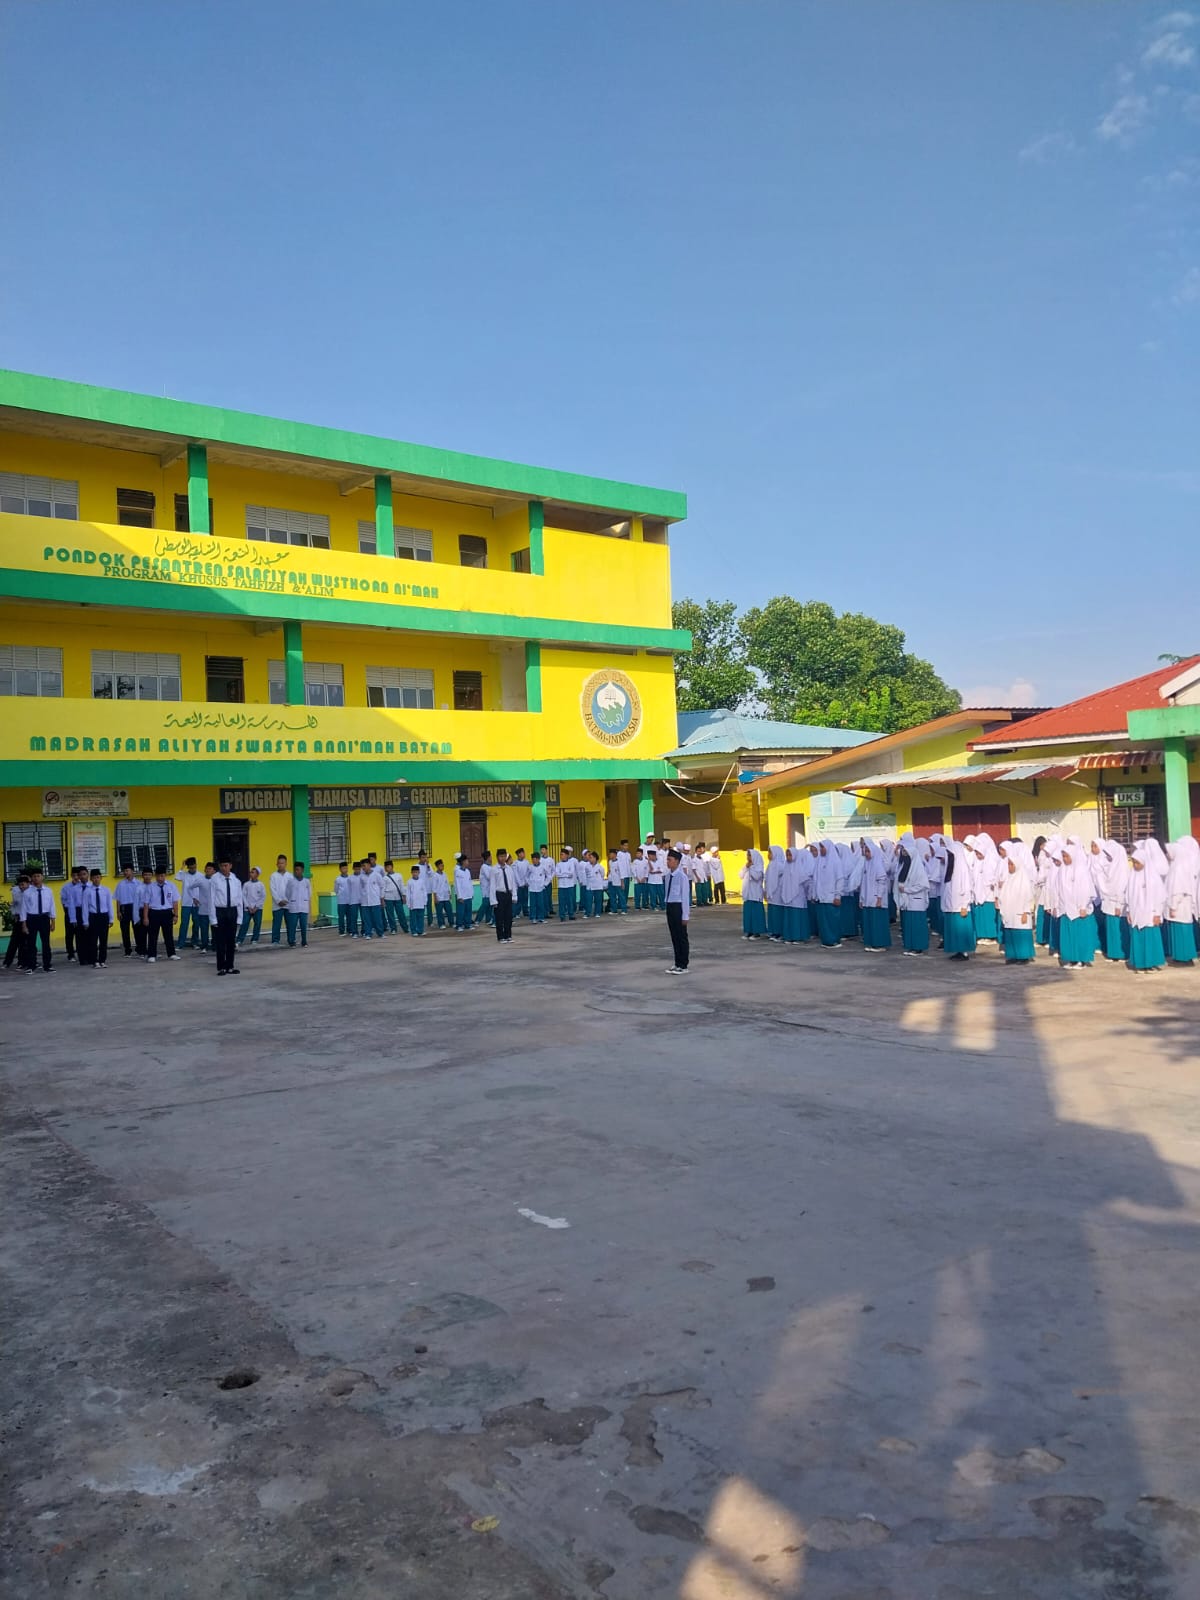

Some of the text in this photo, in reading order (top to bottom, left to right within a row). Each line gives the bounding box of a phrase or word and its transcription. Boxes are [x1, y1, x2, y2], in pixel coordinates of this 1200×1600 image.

[43, 546, 125, 567] PONDOK
[131, 555, 223, 578] PESANTREN
[227, 564, 307, 585] SALAFIYAH
[394, 583, 439, 599] NI'MAH
[103, 566, 172, 582] PROGRAM
[178, 573, 228, 587] KHUSUS
[232, 577, 285, 592] TAHFIZH
[30, 736, 453, 755] MADRASAH ALIYAH SWASTA ANNI'MAH BATAM
[313, 789, 365, 807] BAHASA
[368, 788, 401, 806] ARAB
[410, 787, 459, 805] GERMAN
[467, 786, 512, 803] INGGRIS
[1118, 793, 1142, 802] UKS
